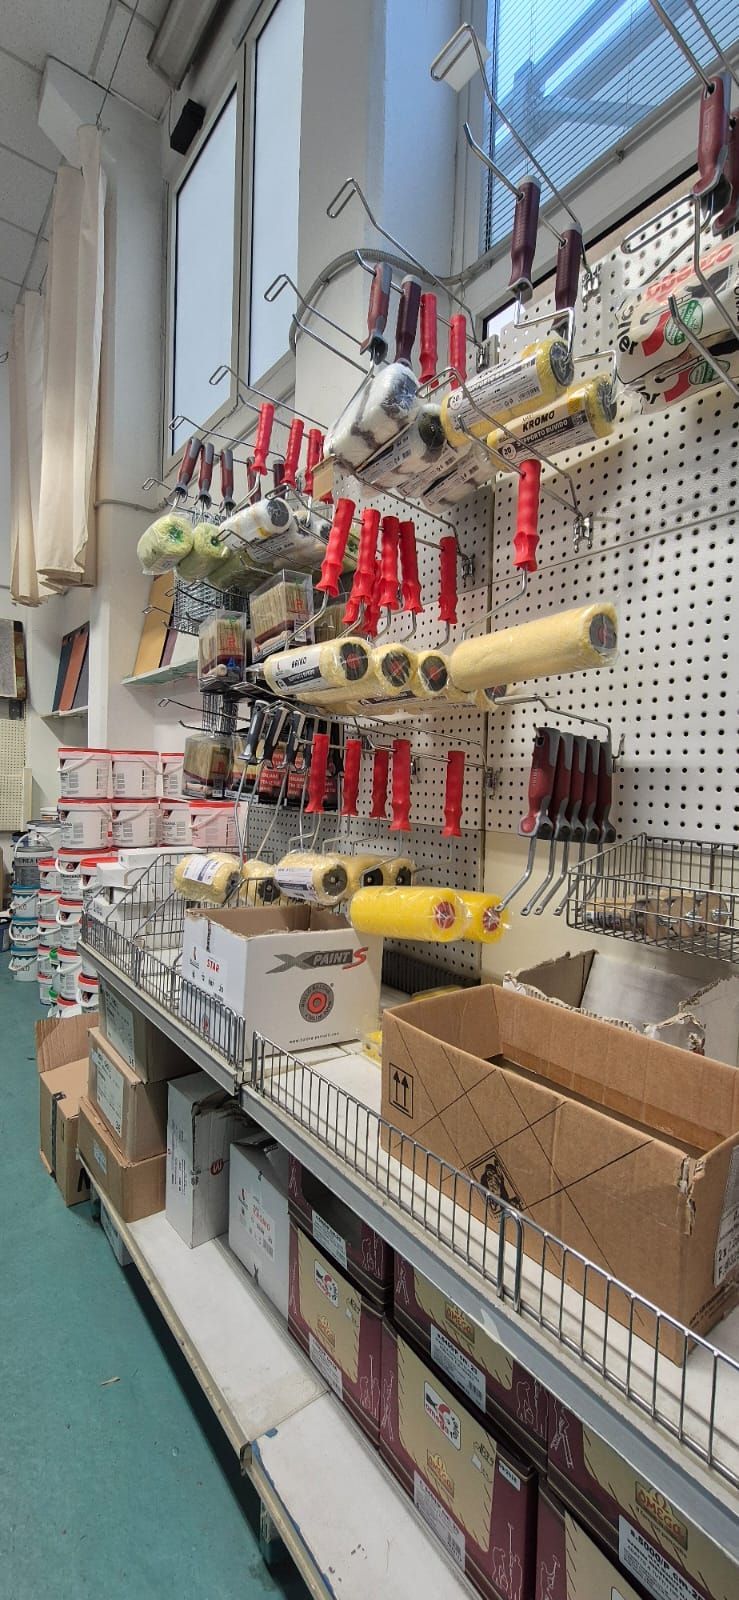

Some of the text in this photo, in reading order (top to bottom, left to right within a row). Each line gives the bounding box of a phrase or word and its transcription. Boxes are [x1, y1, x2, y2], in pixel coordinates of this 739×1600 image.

[522, 410, 555, 432] KROMO
[516, 429, 546, 446] SPPORTO
[637, 1489, 682, 1534] OMEGA
